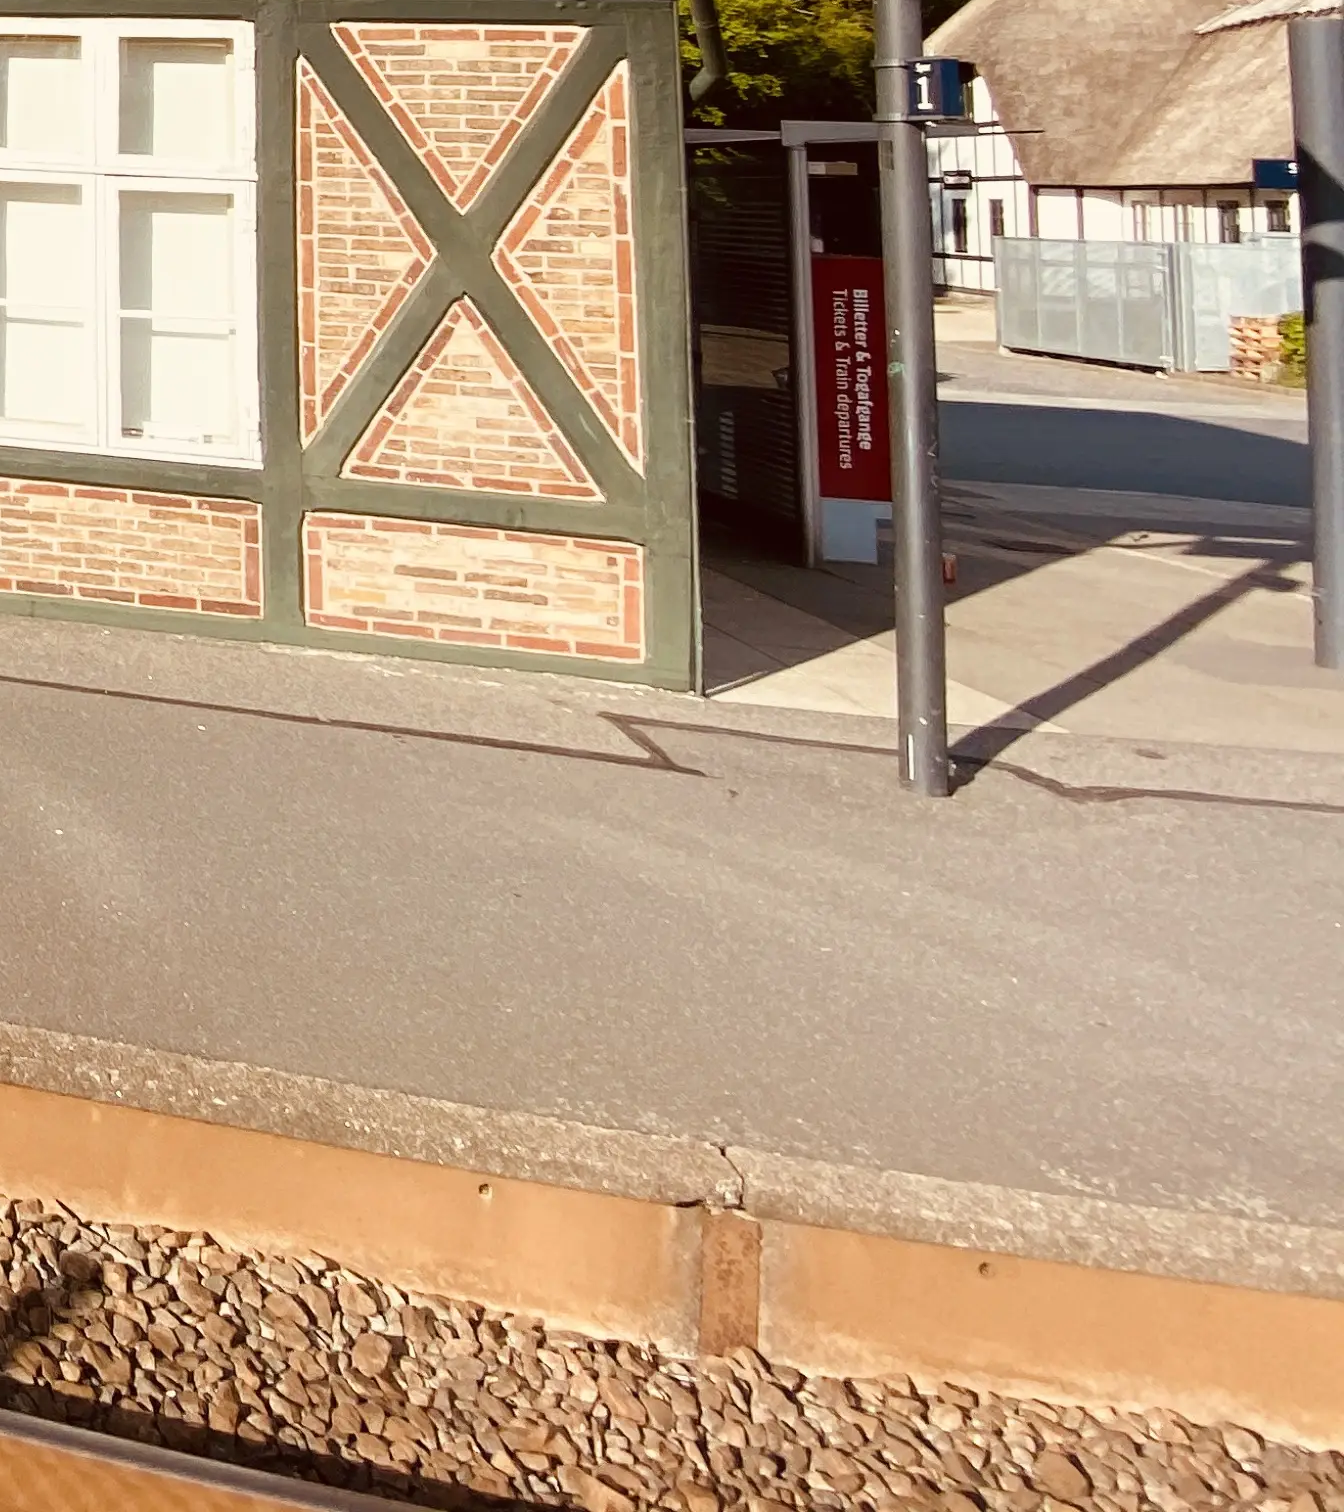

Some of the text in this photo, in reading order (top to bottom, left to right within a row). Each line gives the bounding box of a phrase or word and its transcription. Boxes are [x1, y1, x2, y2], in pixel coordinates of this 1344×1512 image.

[916, 75, 934, 110] 1
[832, 288, 853, 470] Tickets & Train departures
[852, 289, 874, 450] Billetter & Togafgange
